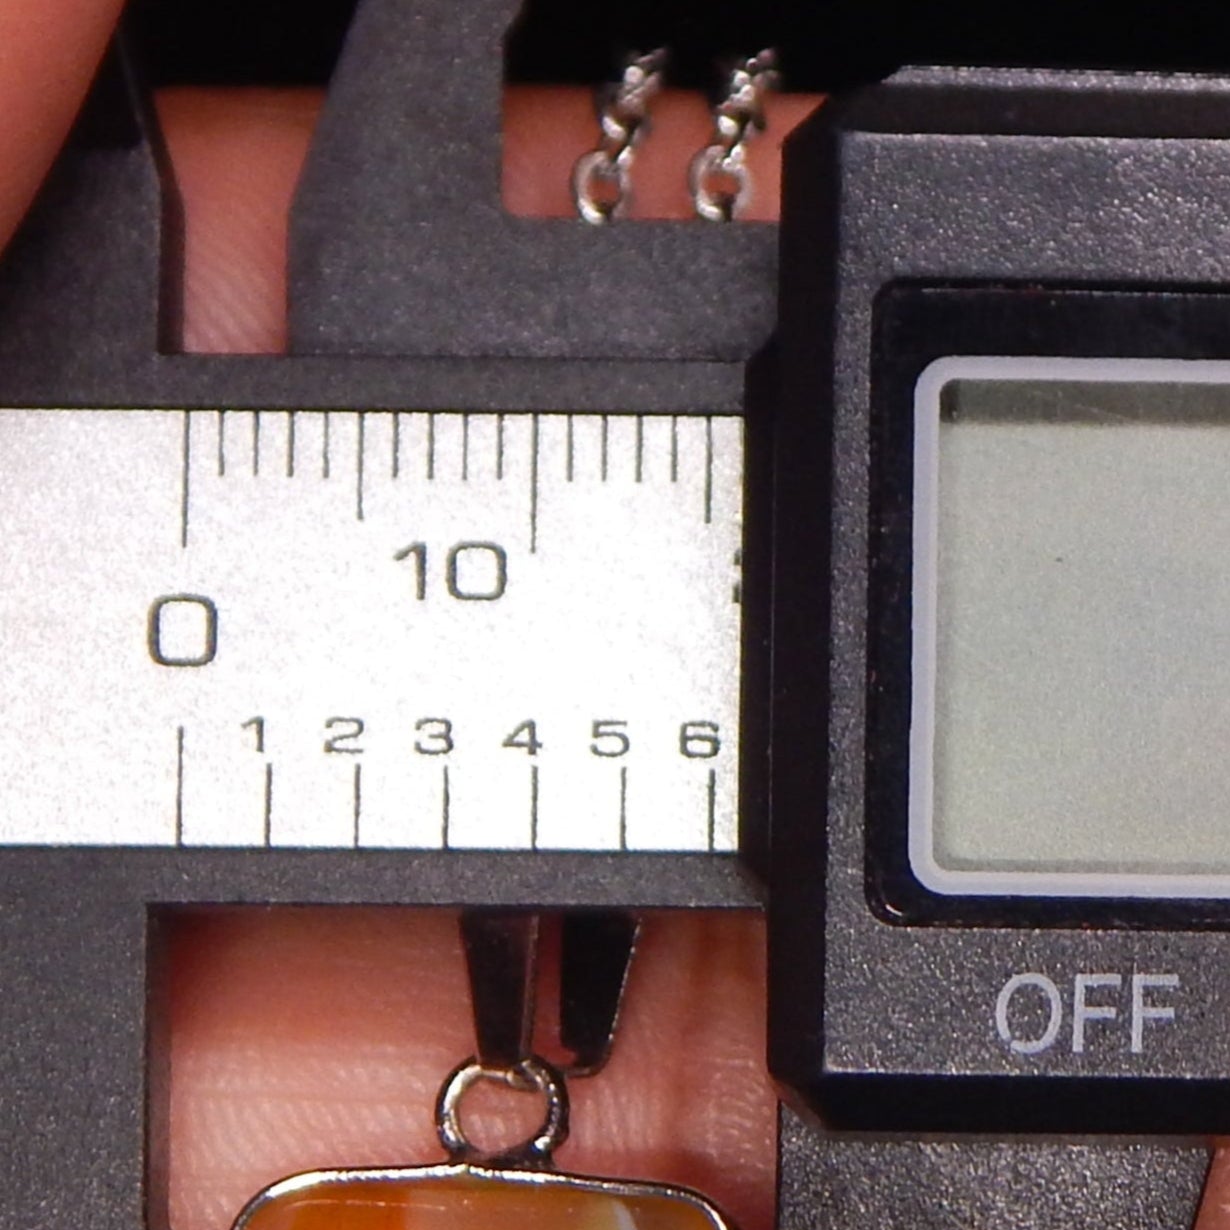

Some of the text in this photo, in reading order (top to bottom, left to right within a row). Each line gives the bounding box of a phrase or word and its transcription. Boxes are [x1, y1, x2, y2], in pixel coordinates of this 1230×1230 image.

[393, 540, 508, 602] 10
[146, 593, 219, 668] 0
[240, 716, 723, 760] 1 2 3 4 5 6
[995, 972, 1180, 1055] OFF
